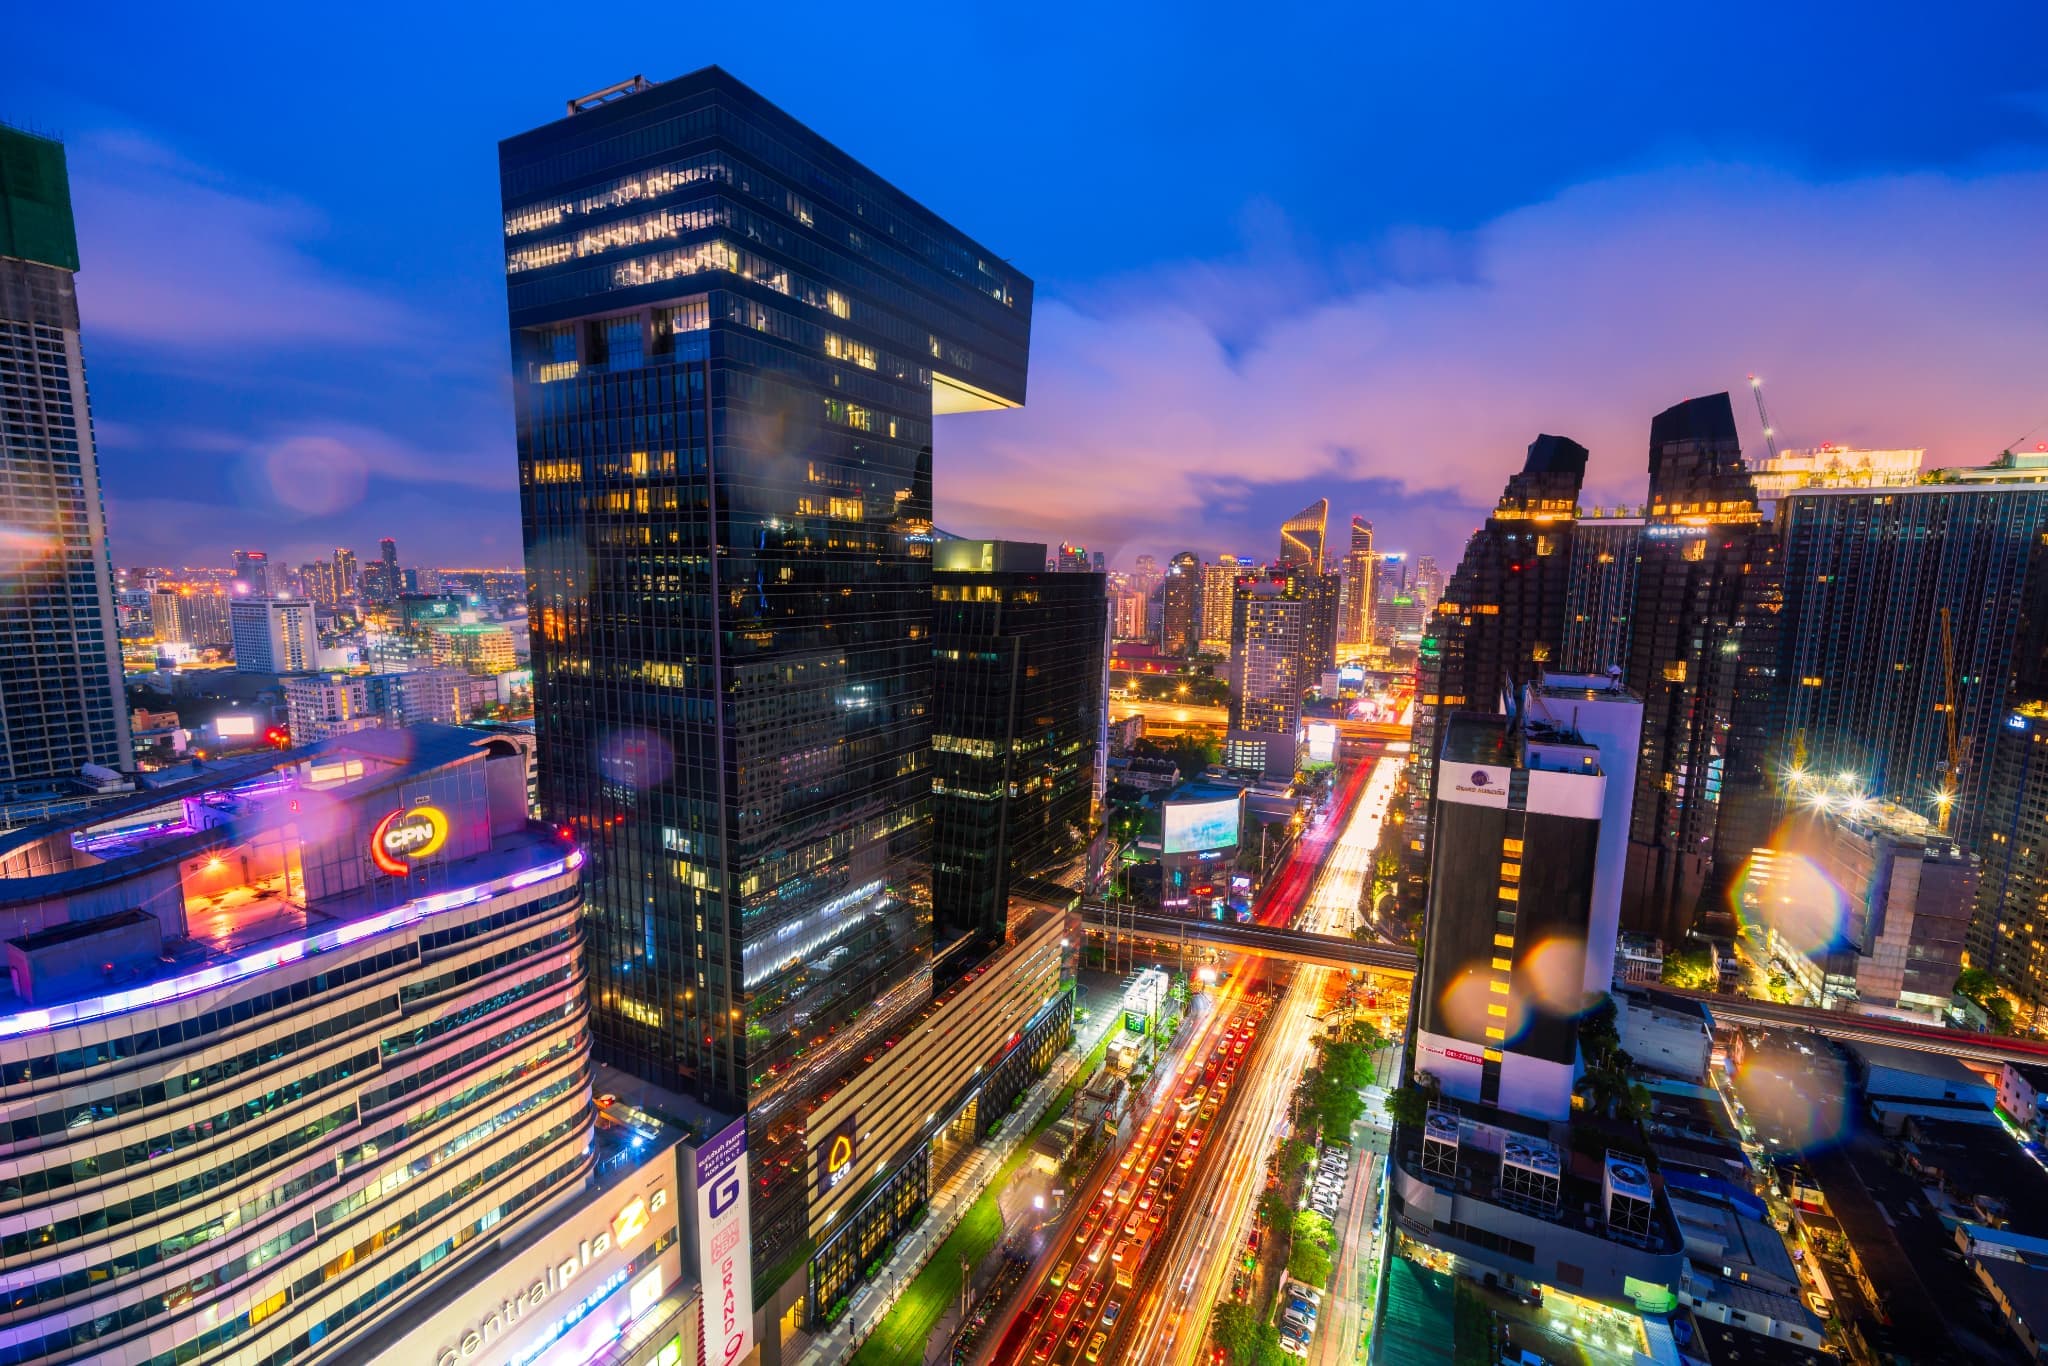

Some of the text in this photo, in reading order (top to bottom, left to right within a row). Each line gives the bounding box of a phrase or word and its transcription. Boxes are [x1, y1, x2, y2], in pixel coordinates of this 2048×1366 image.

[384, 823, 434, 848] CPN
[1129, 1020, 1141, 1031] 5G
[831, 1161, 851, 1186] SCB
[709, 1165, 740, 1219] G
[722, 1256, 735, 1336] GRAND
